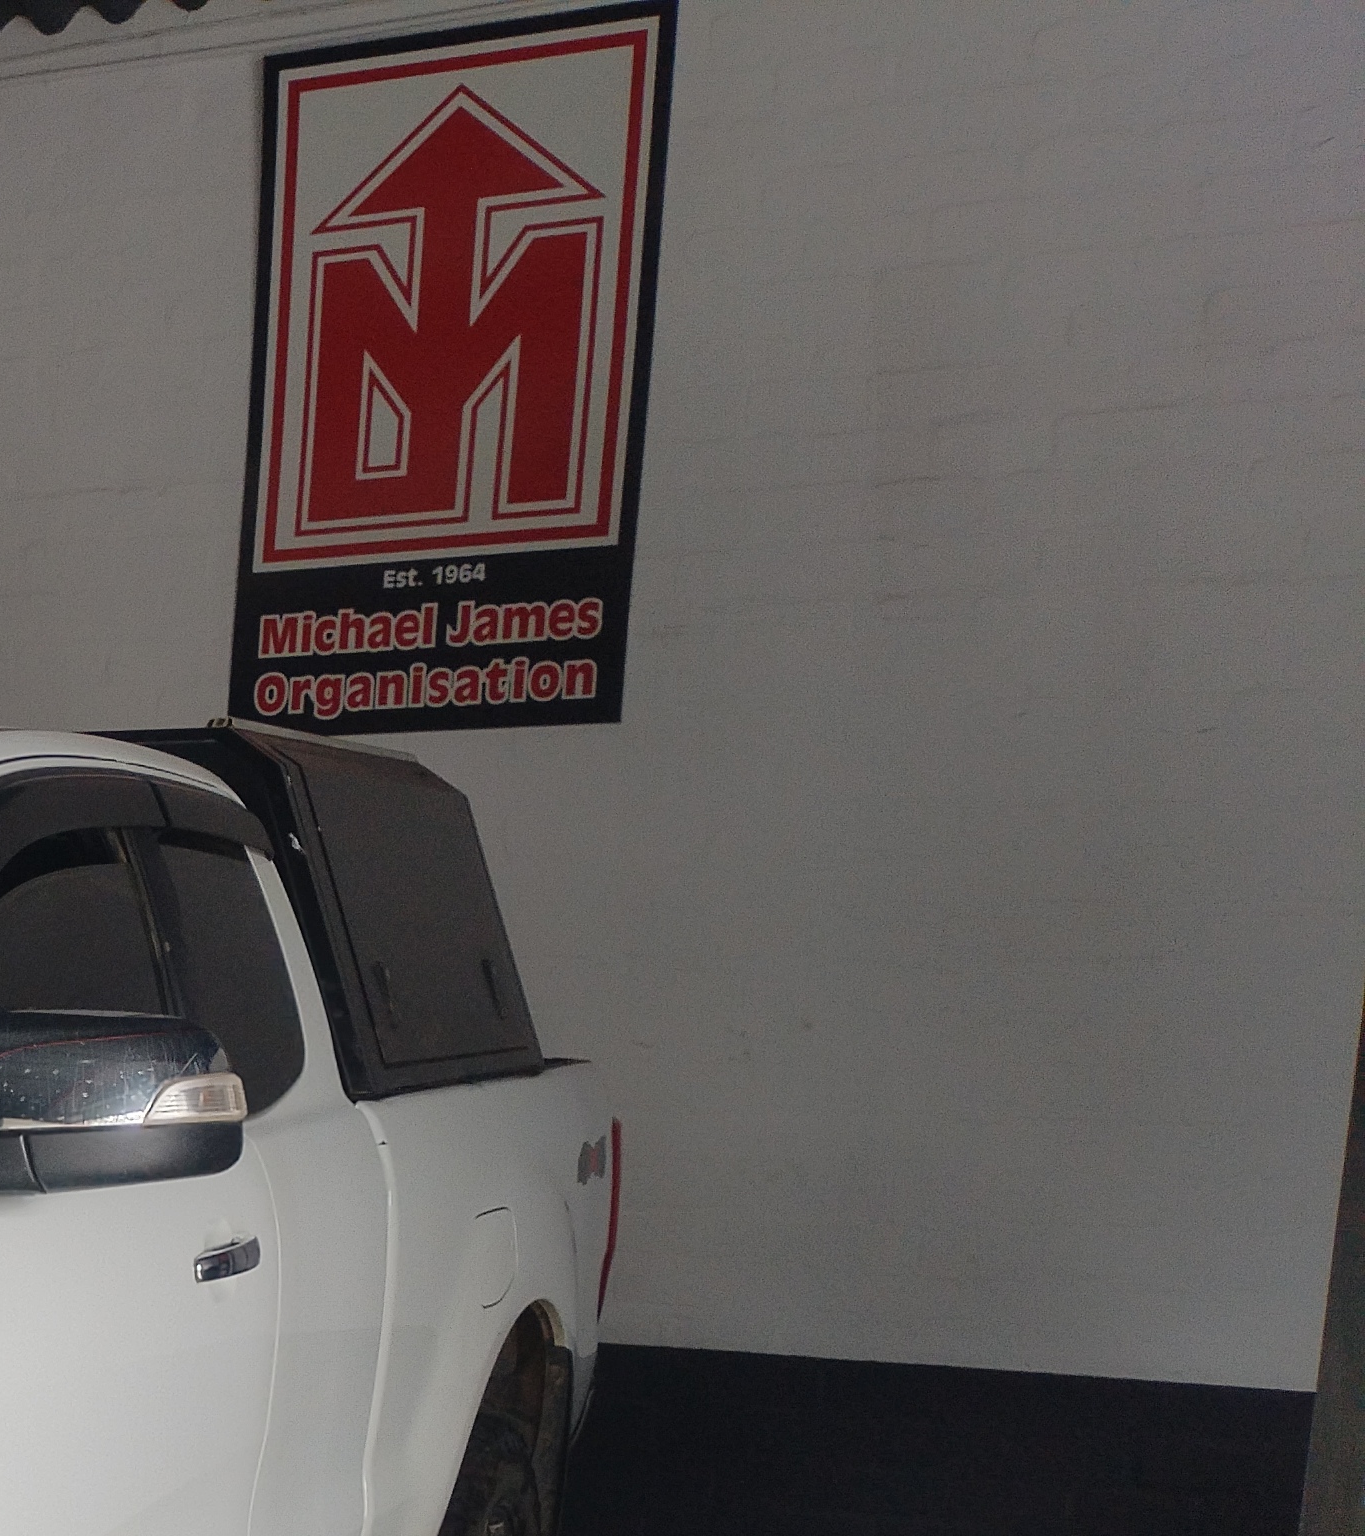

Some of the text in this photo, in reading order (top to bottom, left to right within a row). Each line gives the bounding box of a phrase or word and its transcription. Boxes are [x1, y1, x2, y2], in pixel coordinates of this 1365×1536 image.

[383, 562, 487, 589] Est. 1964
[258, 597, 604, 659] Michael James
[254, 656, 598, 720] Organisation
